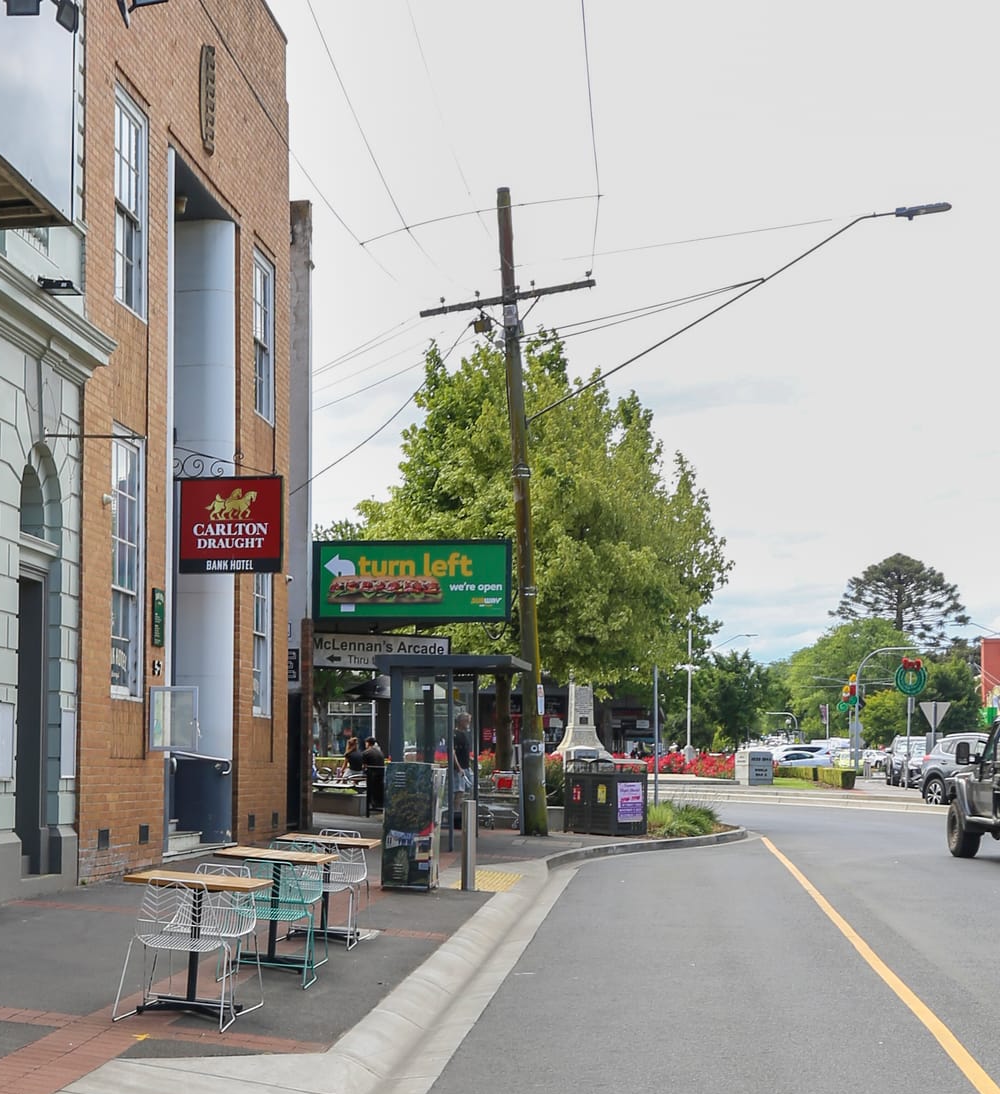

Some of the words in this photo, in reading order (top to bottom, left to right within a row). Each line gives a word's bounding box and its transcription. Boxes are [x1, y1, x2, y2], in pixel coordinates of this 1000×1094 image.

[192, 522, 270, 537] CARLTON
[196, 537, 265, 550] DRAUGHT
[206, 559, 229, 571] BANK
[230, 559, 254, 571] HOTEL
[357, 555, 416, 578] turn
[423, 552, 474, 578] left
[449, 581, 476, 592] we're
[477, 583, 503, 594] open
[313, 637, 393, 653] McLennan's
[397, 641, 445, 655] Arcade
[348, 654, 370, 665] Thru
